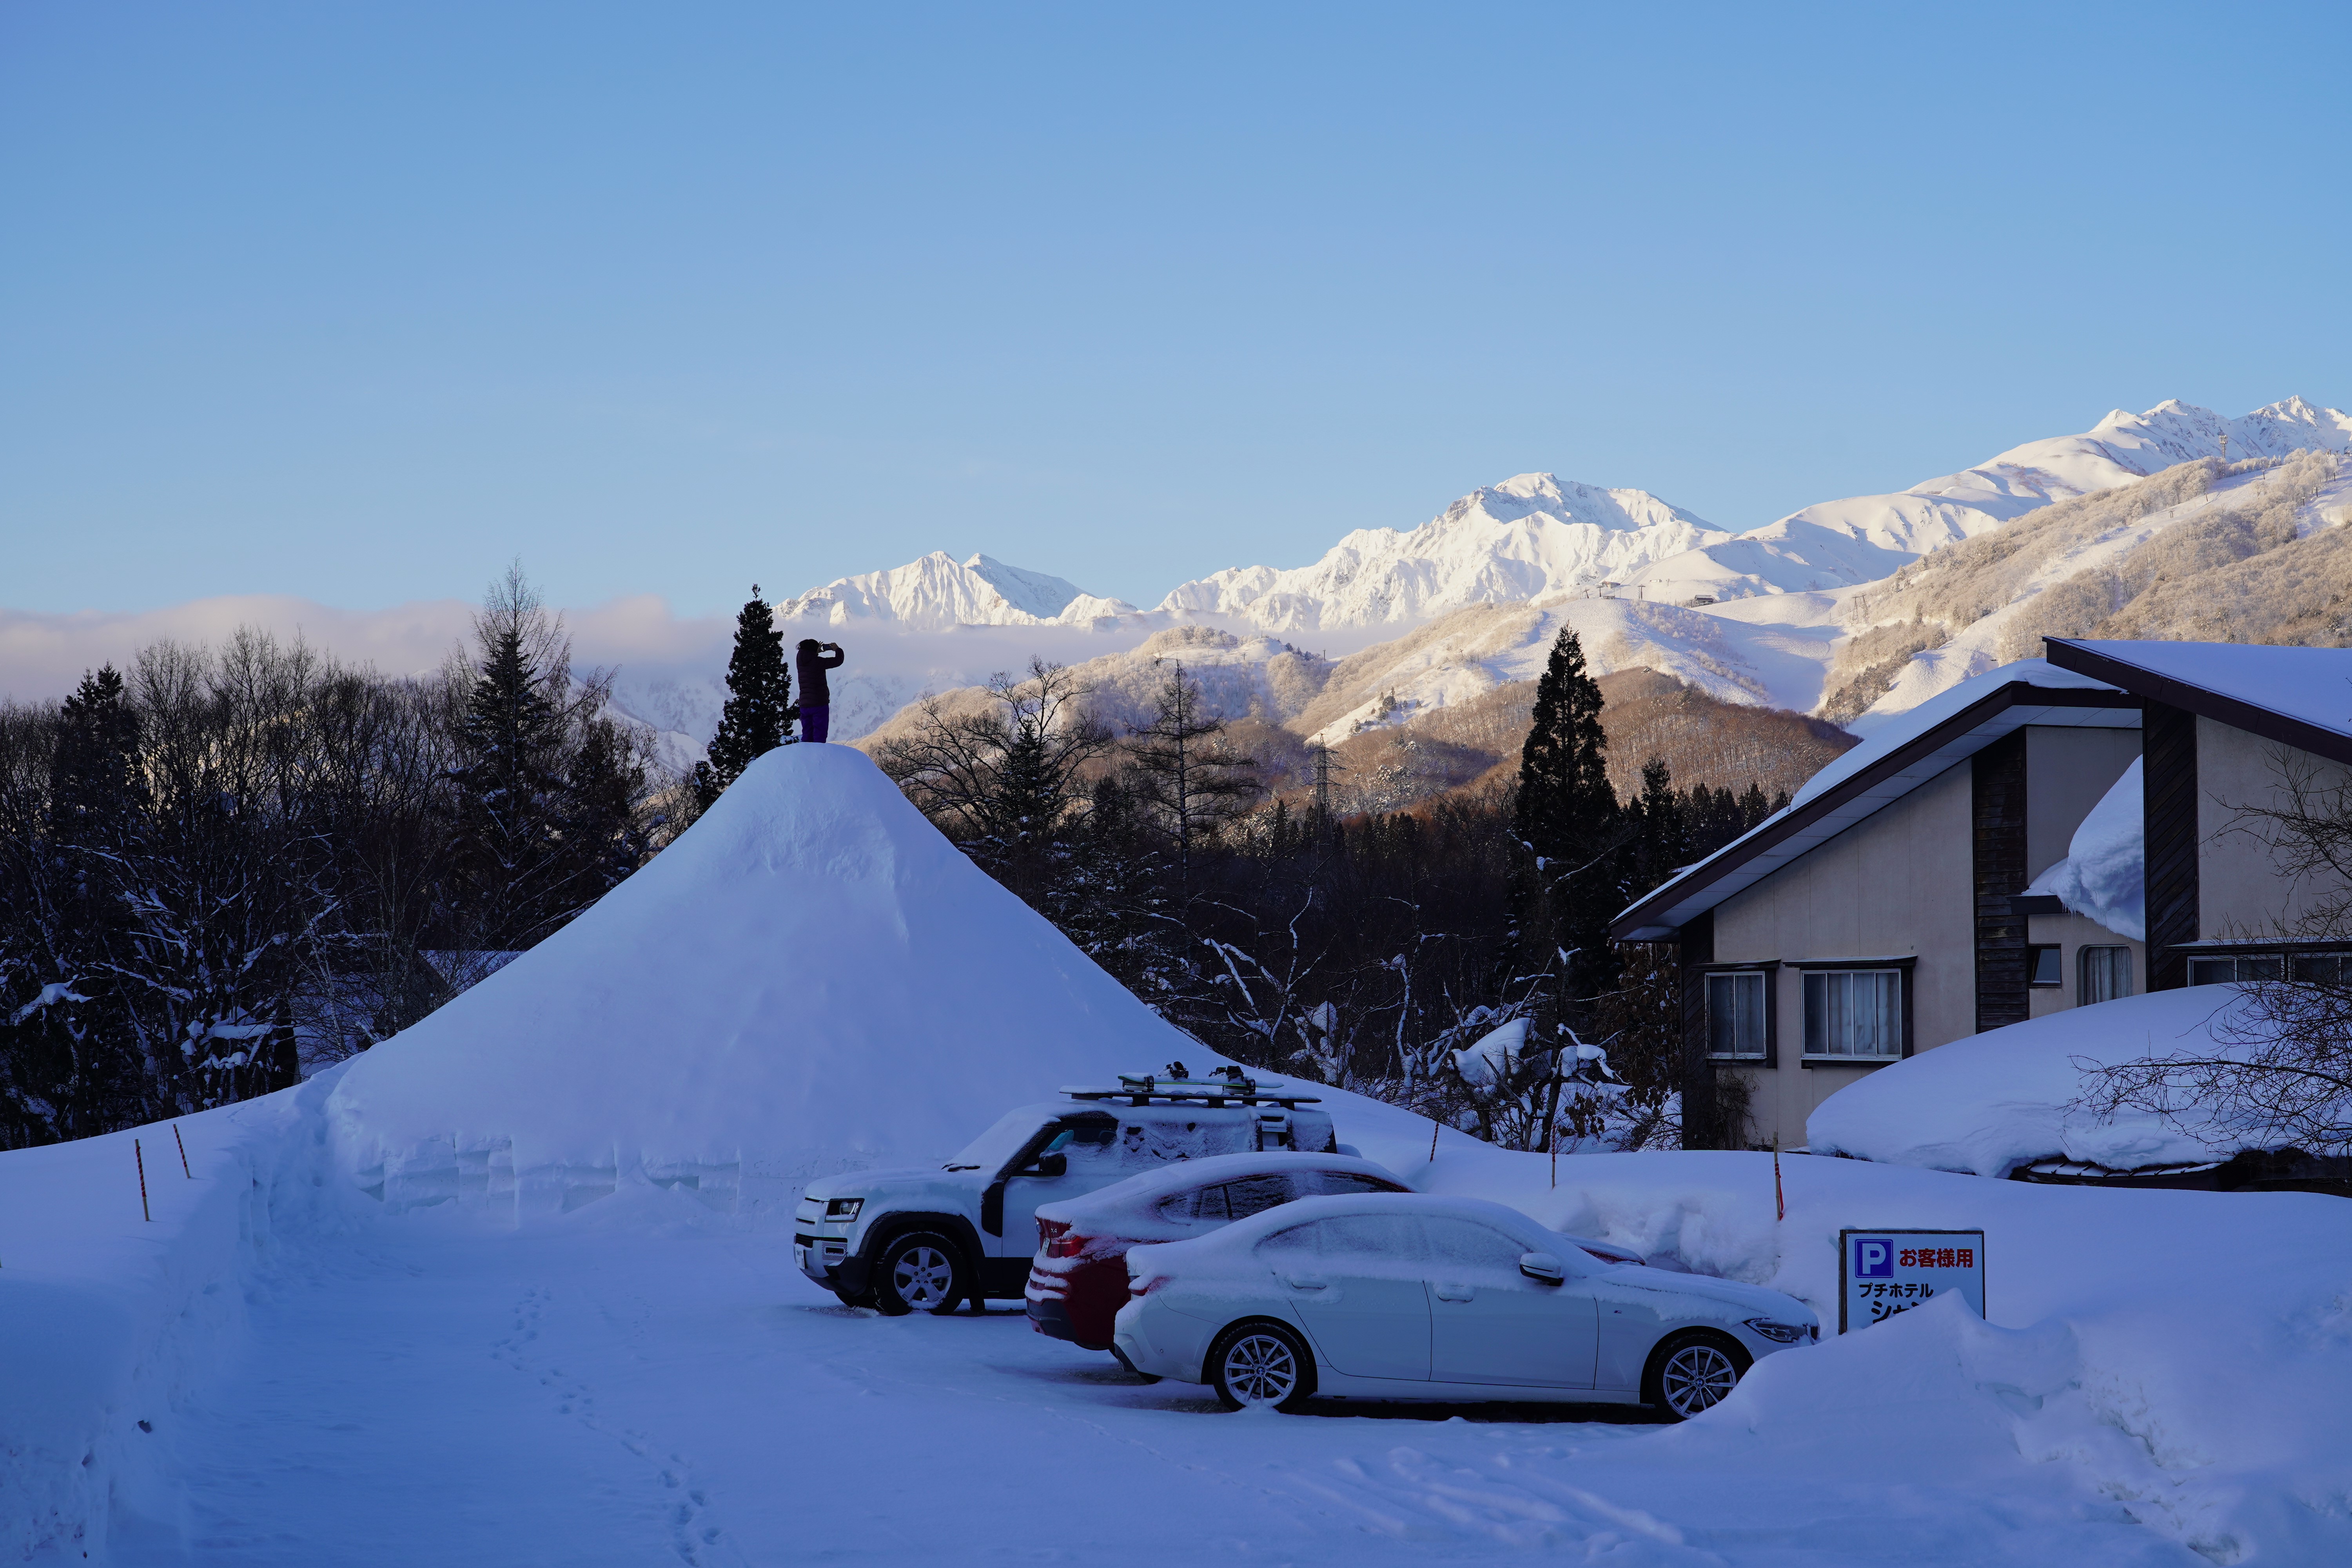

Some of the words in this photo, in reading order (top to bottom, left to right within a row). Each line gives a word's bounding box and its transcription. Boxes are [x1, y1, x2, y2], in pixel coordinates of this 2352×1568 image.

[1862, 1243, 1886, 1274] P
[1900, 1249, 1973, 1268] お客様用
[1859, 1283, 1933, 1298] プチホテル
